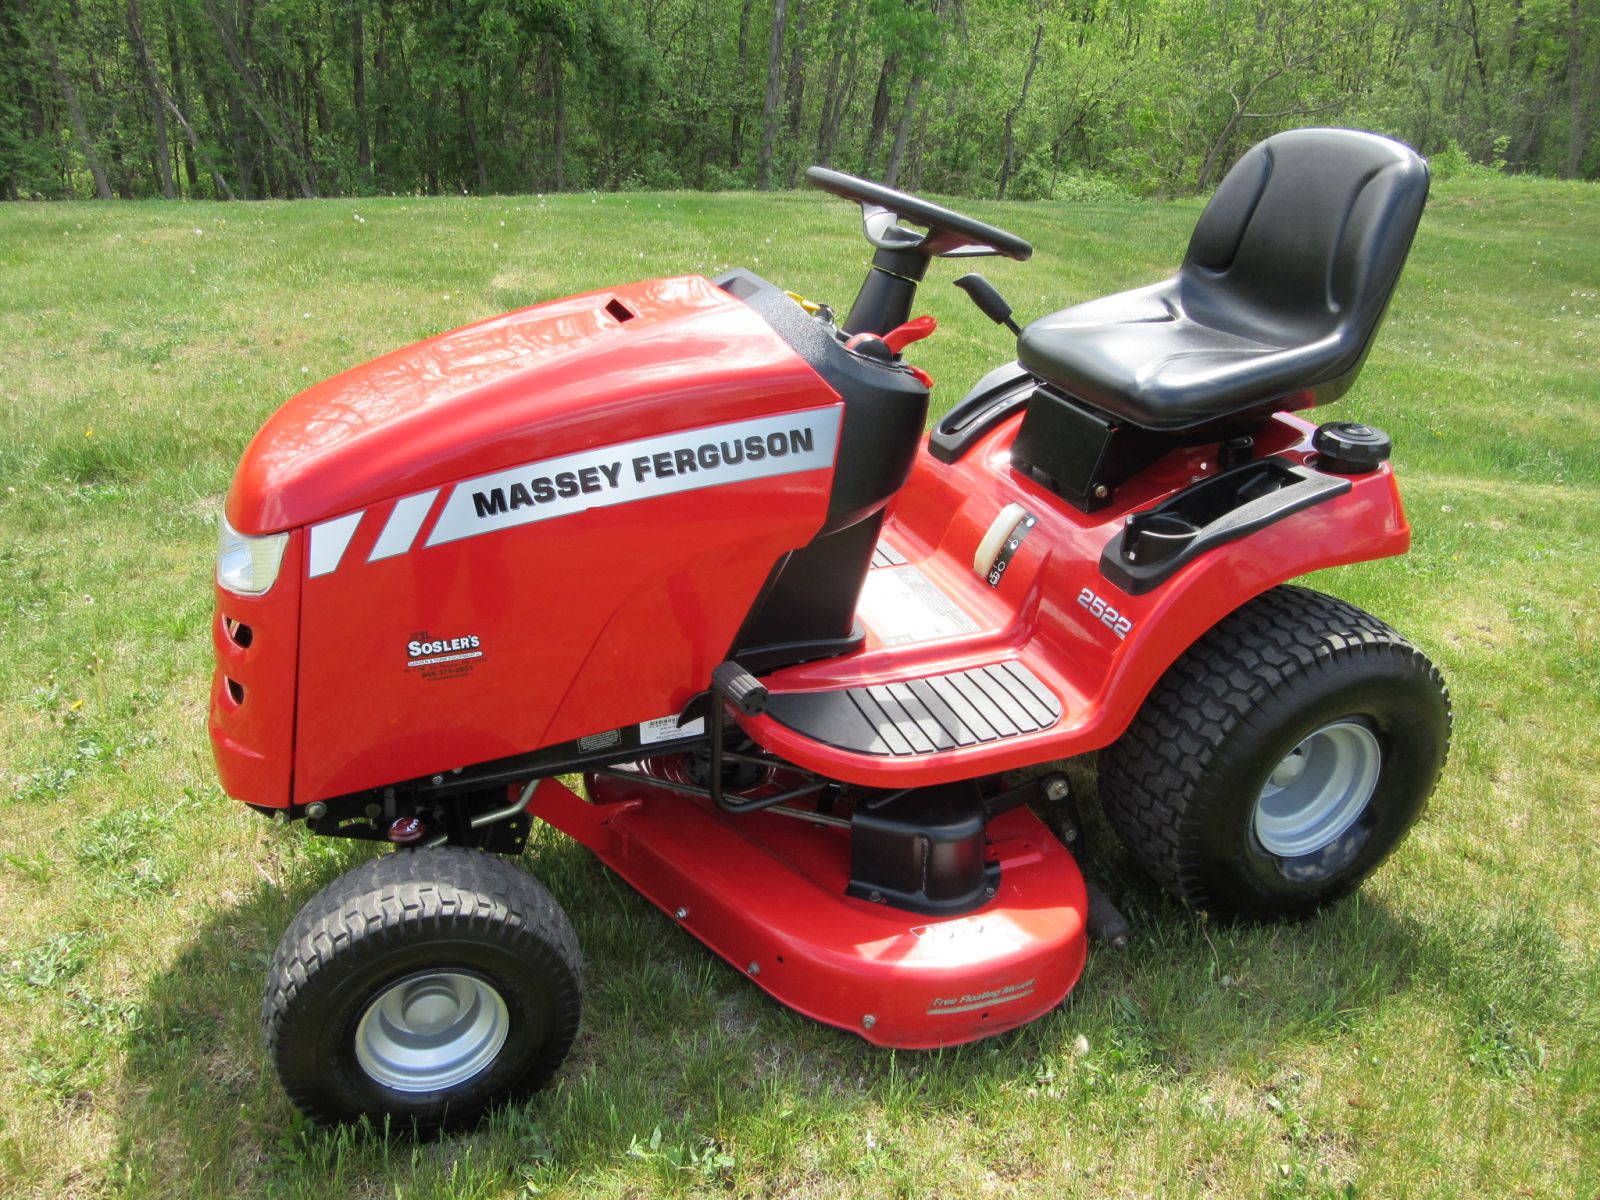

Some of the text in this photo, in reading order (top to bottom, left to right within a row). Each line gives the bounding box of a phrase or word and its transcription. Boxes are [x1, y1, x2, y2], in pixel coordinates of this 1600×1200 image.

[472, 428, 814, 518] MASSEY FERGUSON
[1077, 588, 1132, 640] 2522
[408, 635, 480, 656] SOSLER'S
[933, 998, 957, 1006] Free
[959, 990, 1001, 1003] Floating
